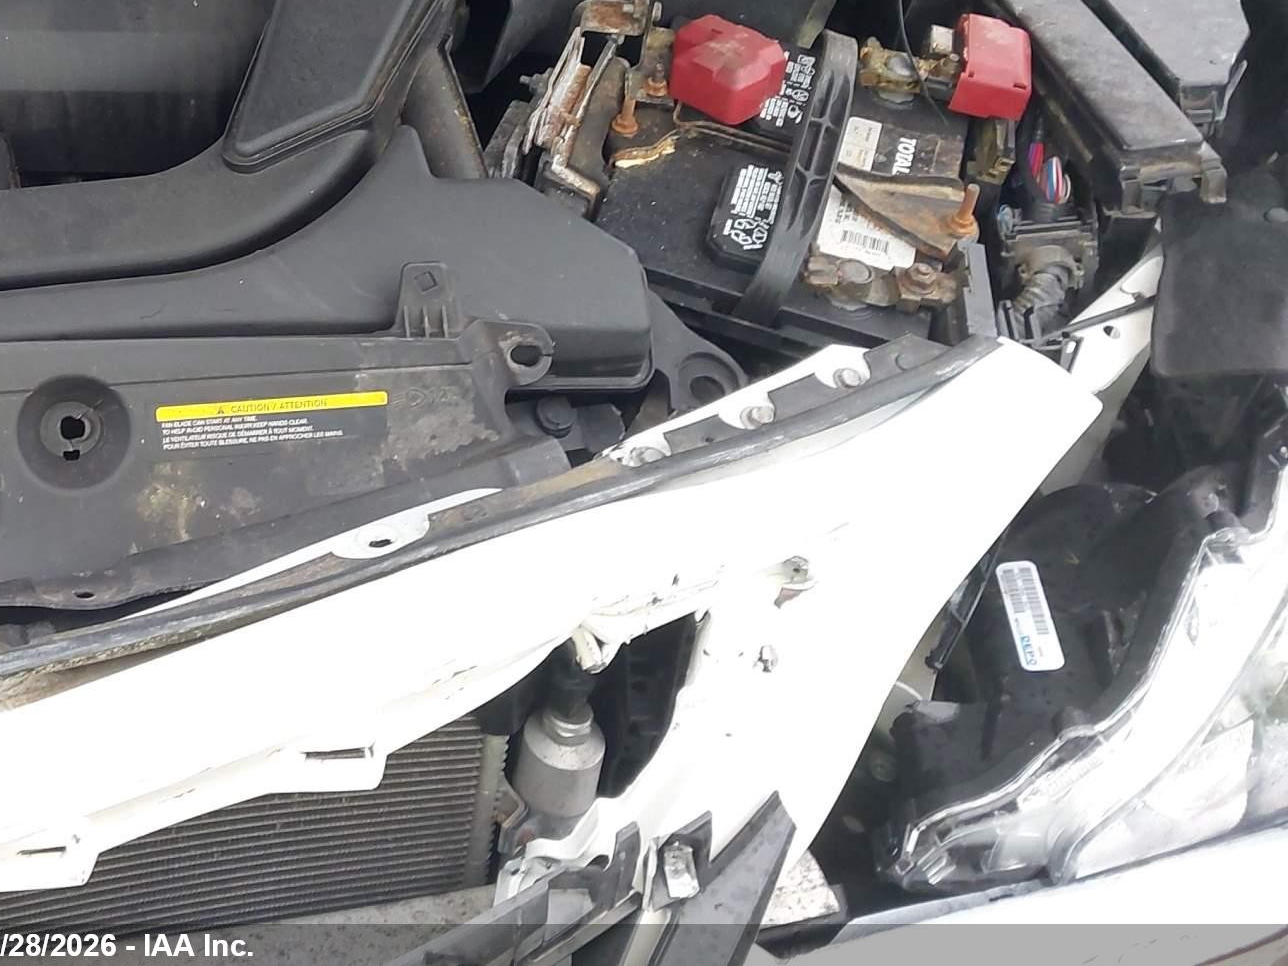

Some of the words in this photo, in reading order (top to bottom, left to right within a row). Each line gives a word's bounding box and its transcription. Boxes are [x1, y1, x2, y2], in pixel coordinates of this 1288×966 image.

[892, 137, 917, 175] TOTAL
[230, 403, 269, 413] CAUTION
[279, 399, 327, 409] ATTENTION
[1020, 635, 1037, 665] DEPO
